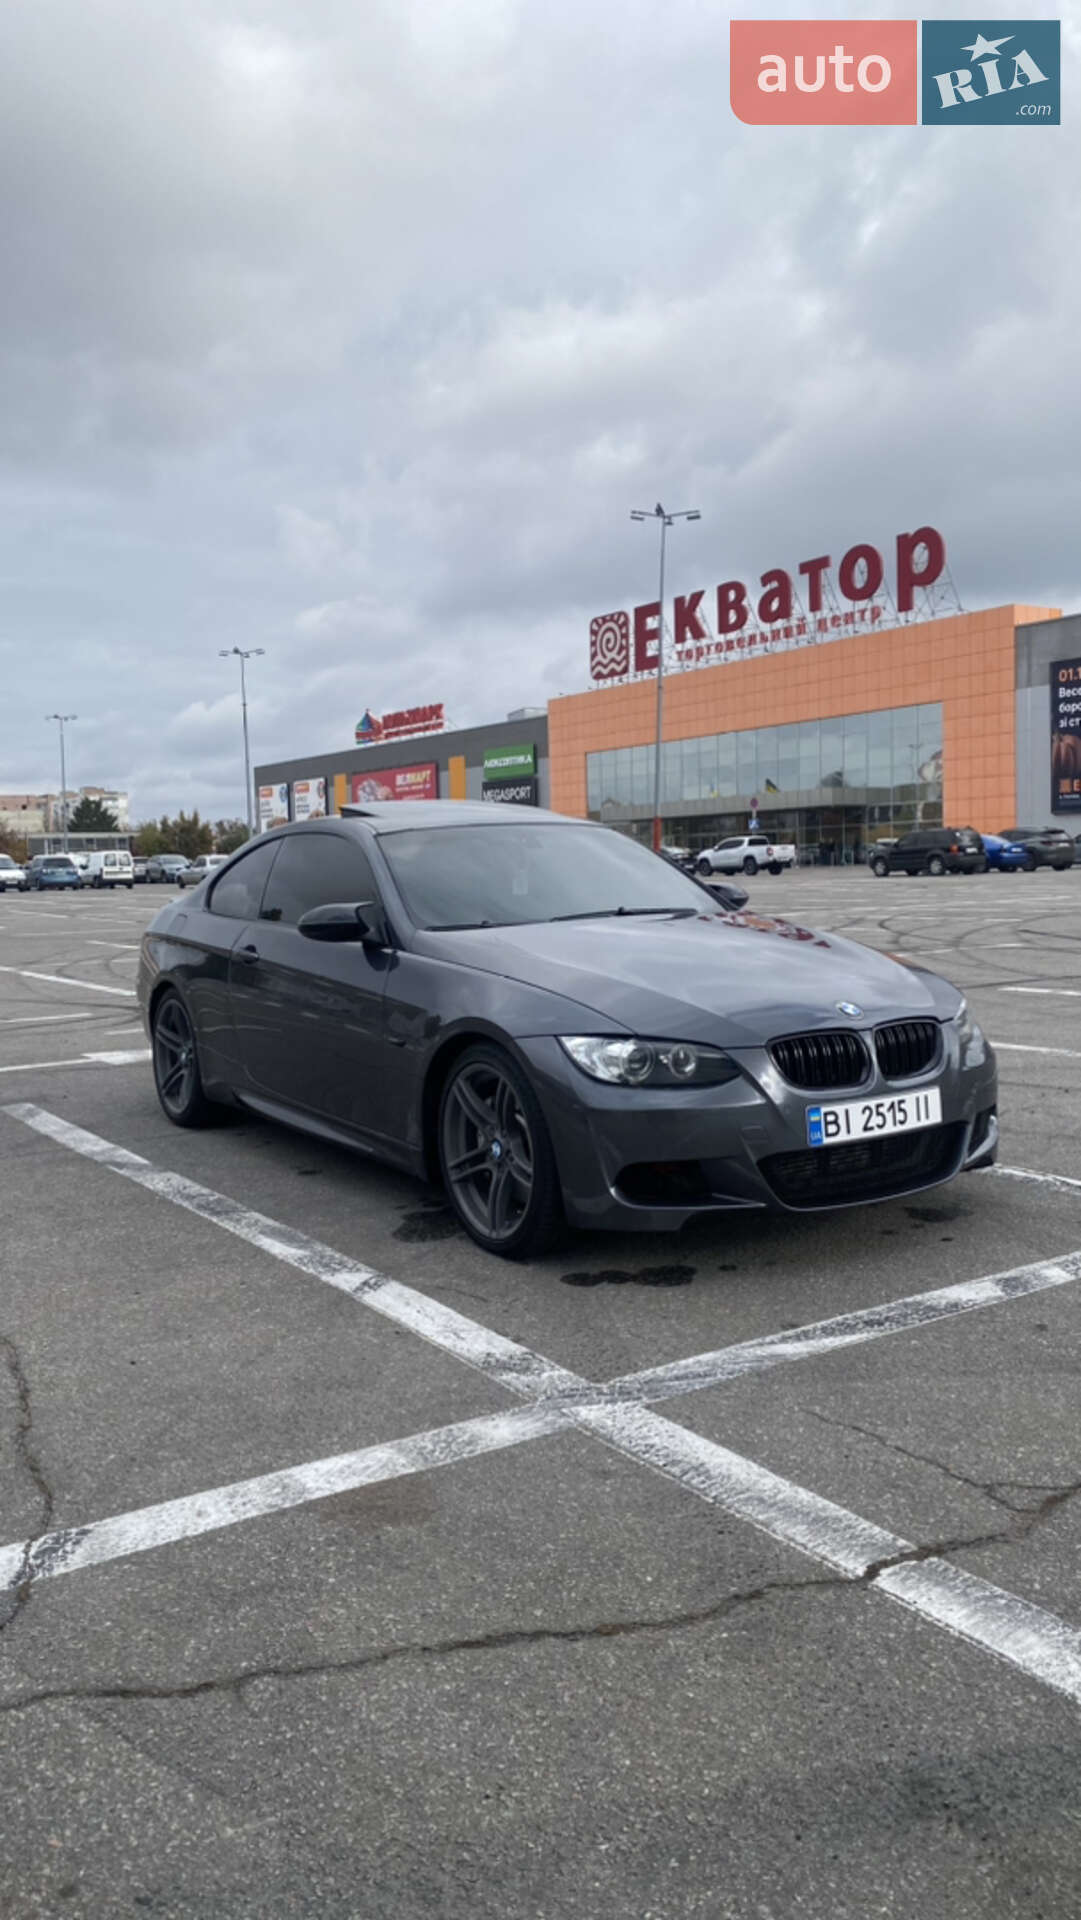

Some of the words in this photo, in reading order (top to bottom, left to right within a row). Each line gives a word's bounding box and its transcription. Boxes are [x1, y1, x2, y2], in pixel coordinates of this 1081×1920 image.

[817, 606, 883, 633] центр
[483, 786, 531, 800] MEGASPORT
[824, 1109, 851, 1138] BI
[862, 1099, 908, 1133] 2515
[916, 1094, 930, 1121] II
